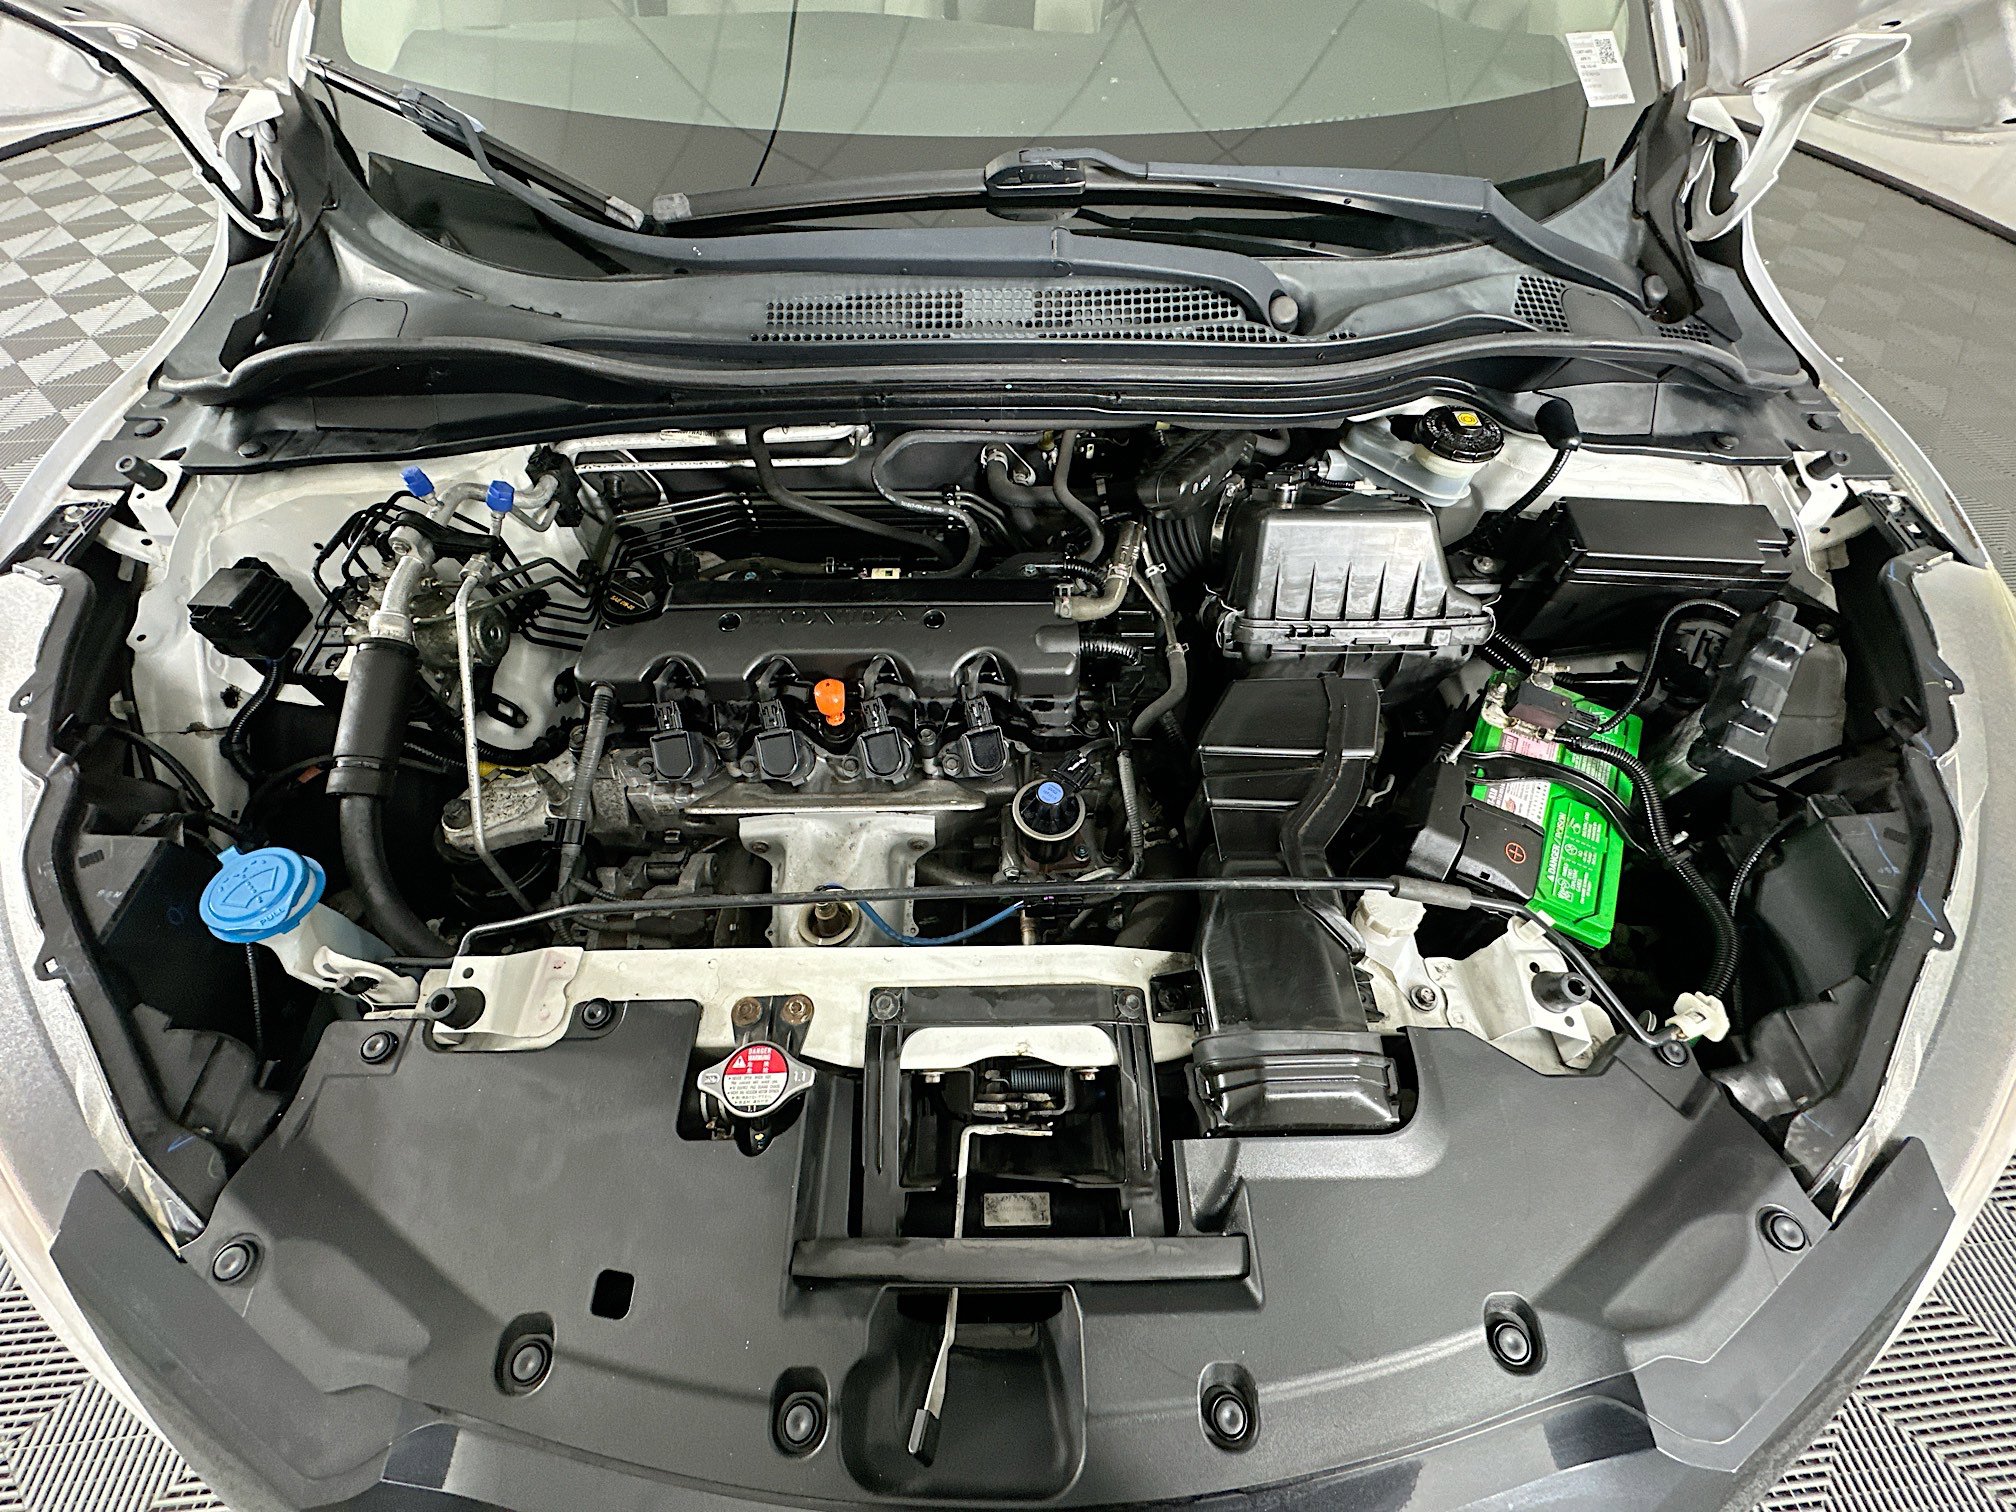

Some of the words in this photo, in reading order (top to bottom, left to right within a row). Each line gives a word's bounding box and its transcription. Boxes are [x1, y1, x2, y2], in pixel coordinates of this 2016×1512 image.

[1547, 844, 1560, 875] DANGER
[1555, 812, 1567, 838] POISON
[259, 908, 286, 926] PULL
[794, 1071, 806, 1082] 1.1
